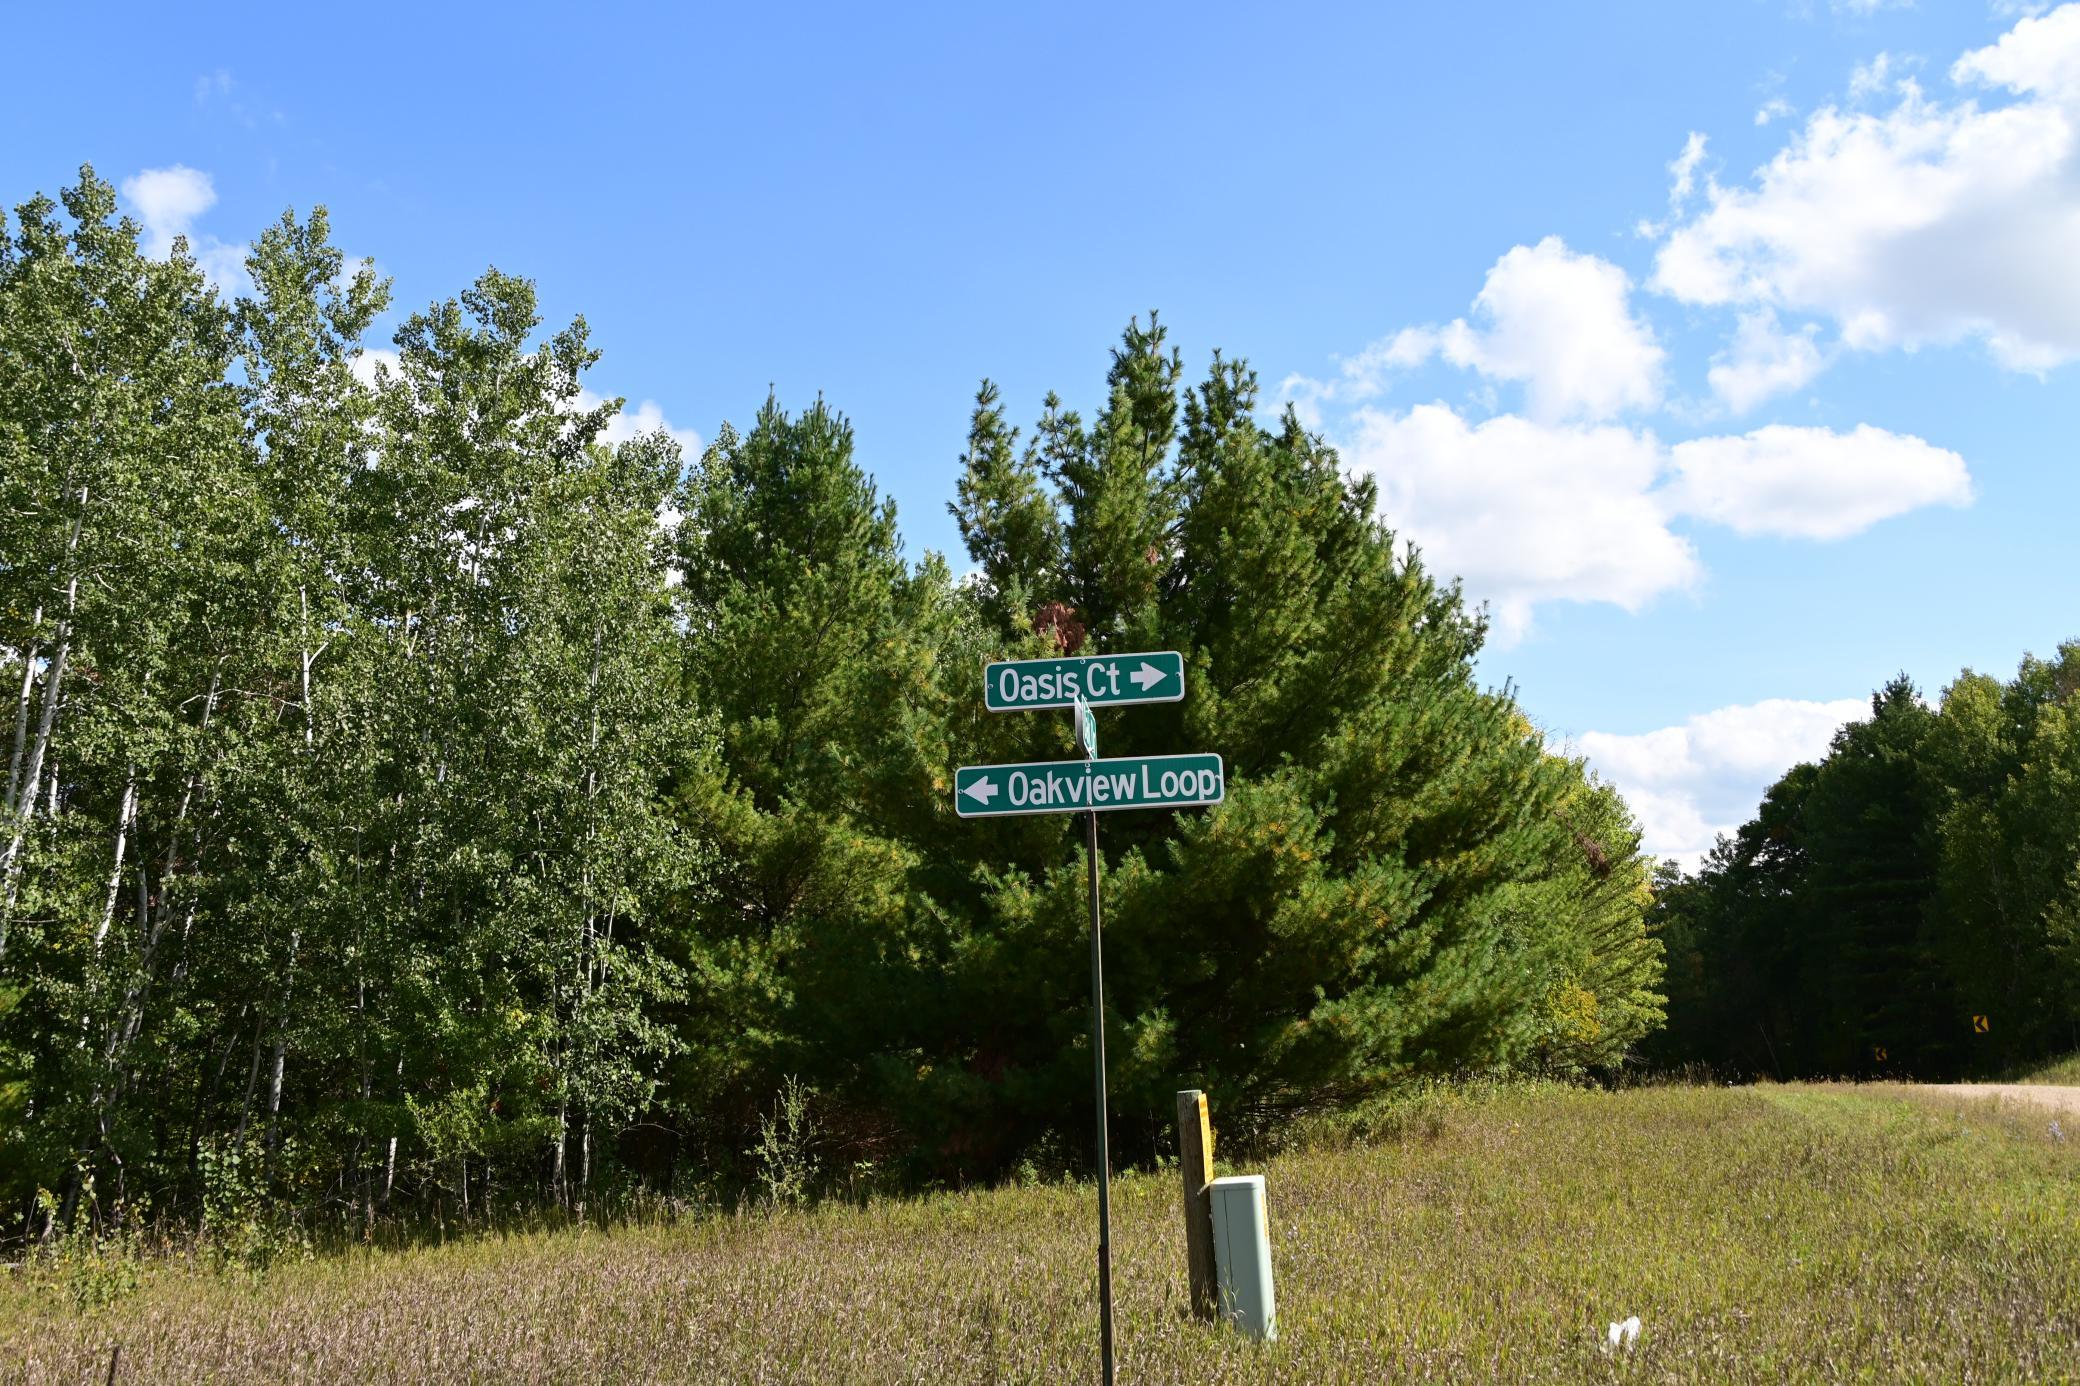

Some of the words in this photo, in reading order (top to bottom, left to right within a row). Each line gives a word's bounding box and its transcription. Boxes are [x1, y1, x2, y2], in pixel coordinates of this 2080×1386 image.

[1000, 666, 1079, 702] Oasis
[1087, 662, 1120, 697] Ct
[1008, 768, 1136, 805] Oakview
[1142, 764, 1216, 800] Loop
